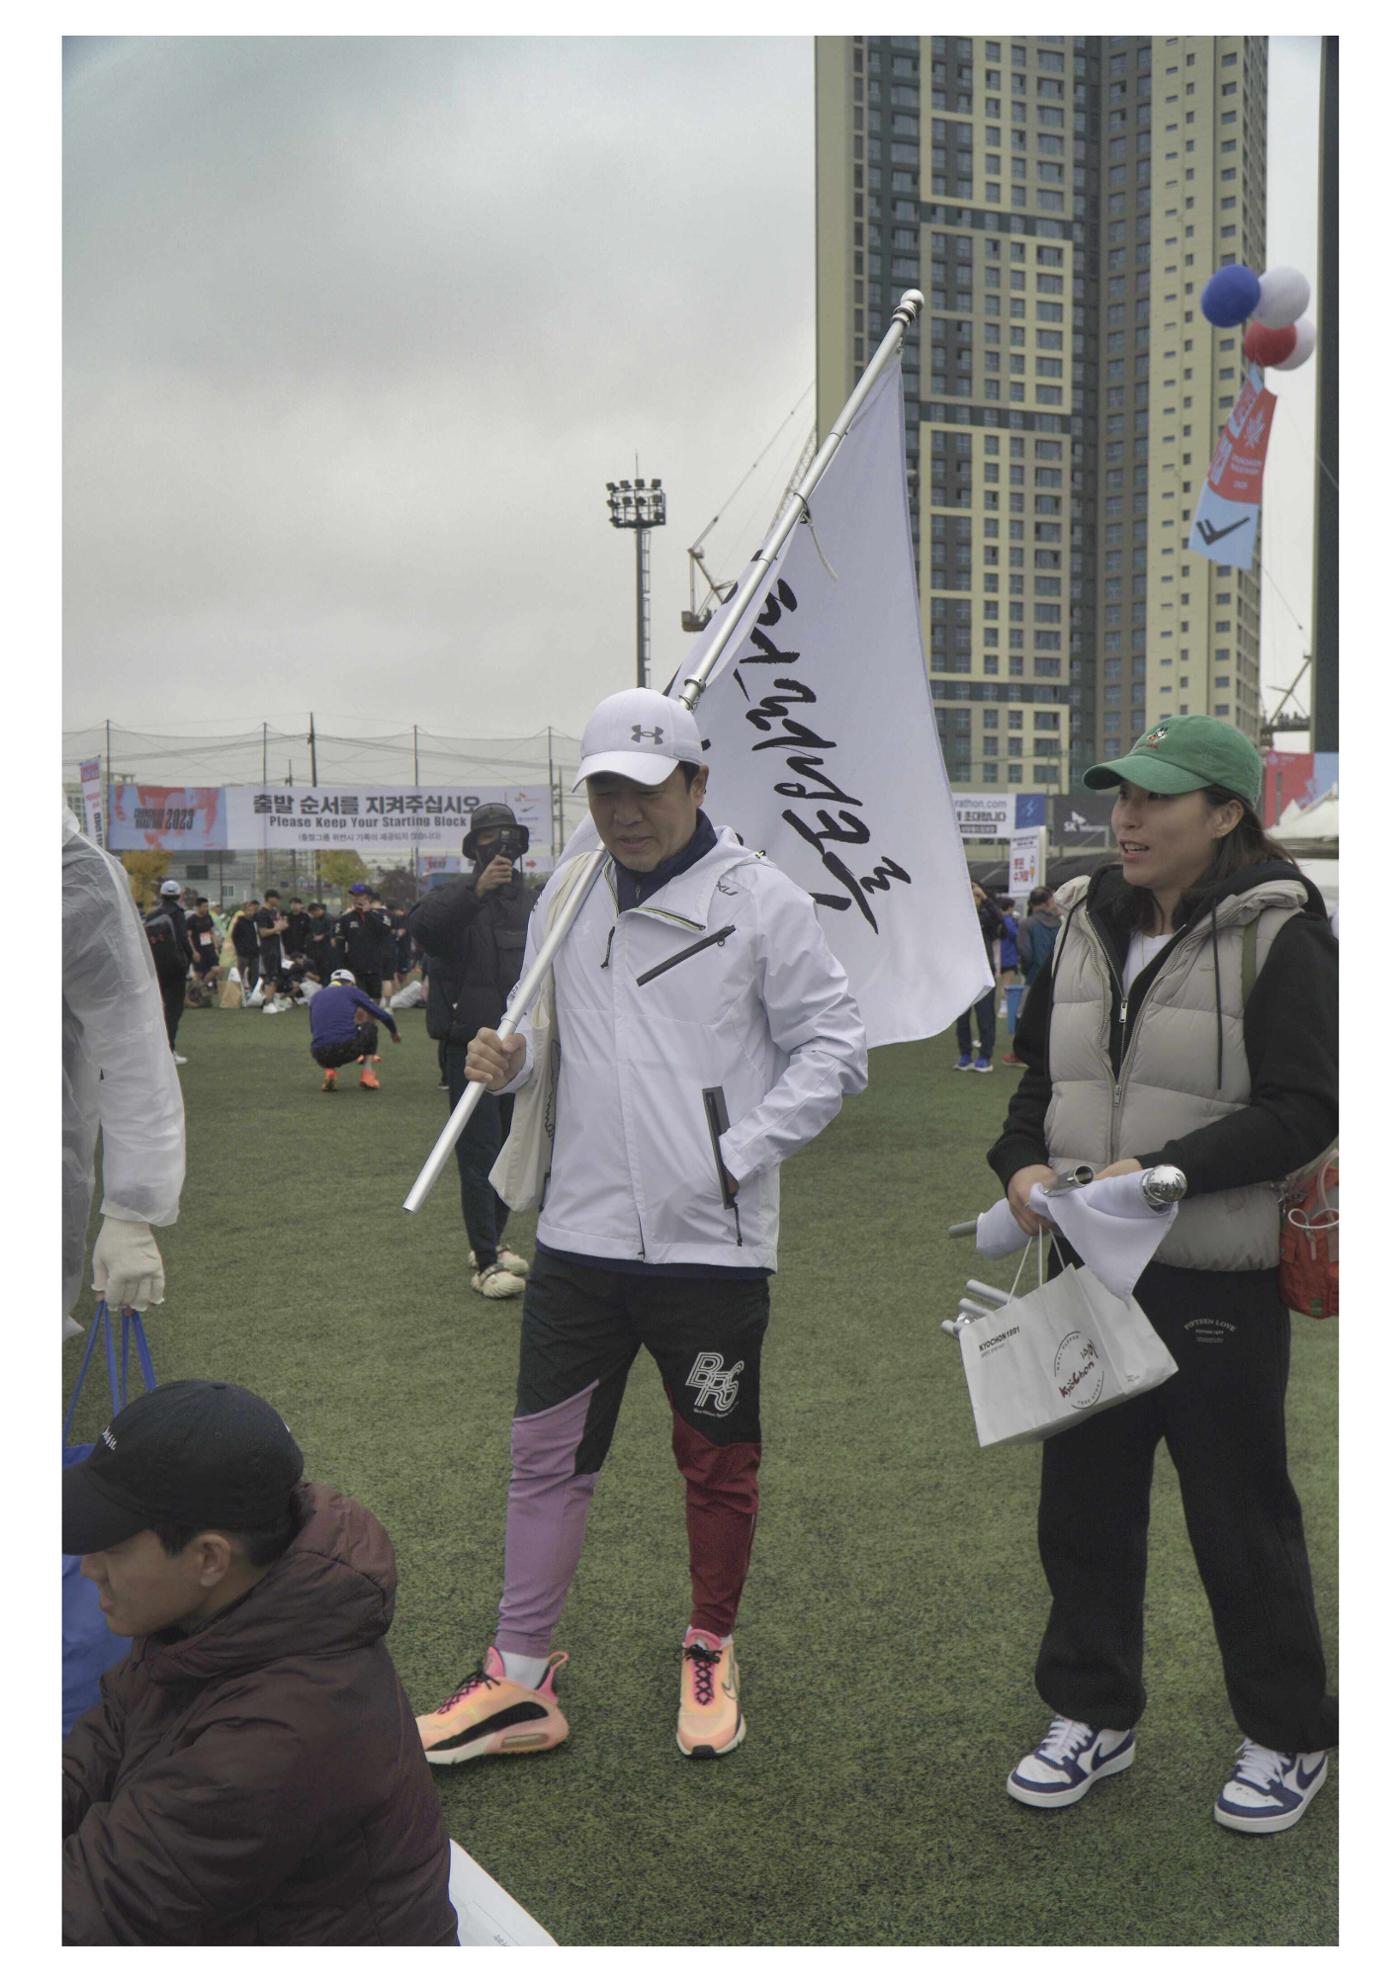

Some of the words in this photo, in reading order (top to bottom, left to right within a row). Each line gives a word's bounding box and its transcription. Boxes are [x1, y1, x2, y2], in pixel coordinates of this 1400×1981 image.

[253, 794, 294, 814] 출발
[300, 795, 359, 815] 순서를
[366, 794, 480, 815] 지켜주십시오
[166, 808, 194, 830] 2023
[269, 816, 311, 828] Please
[316, 817, 347, 829] Keep
[351, 817, 378, 828] Your
[382, 816, 430, 827] Starting
[434, 816, 466, 826] Block
